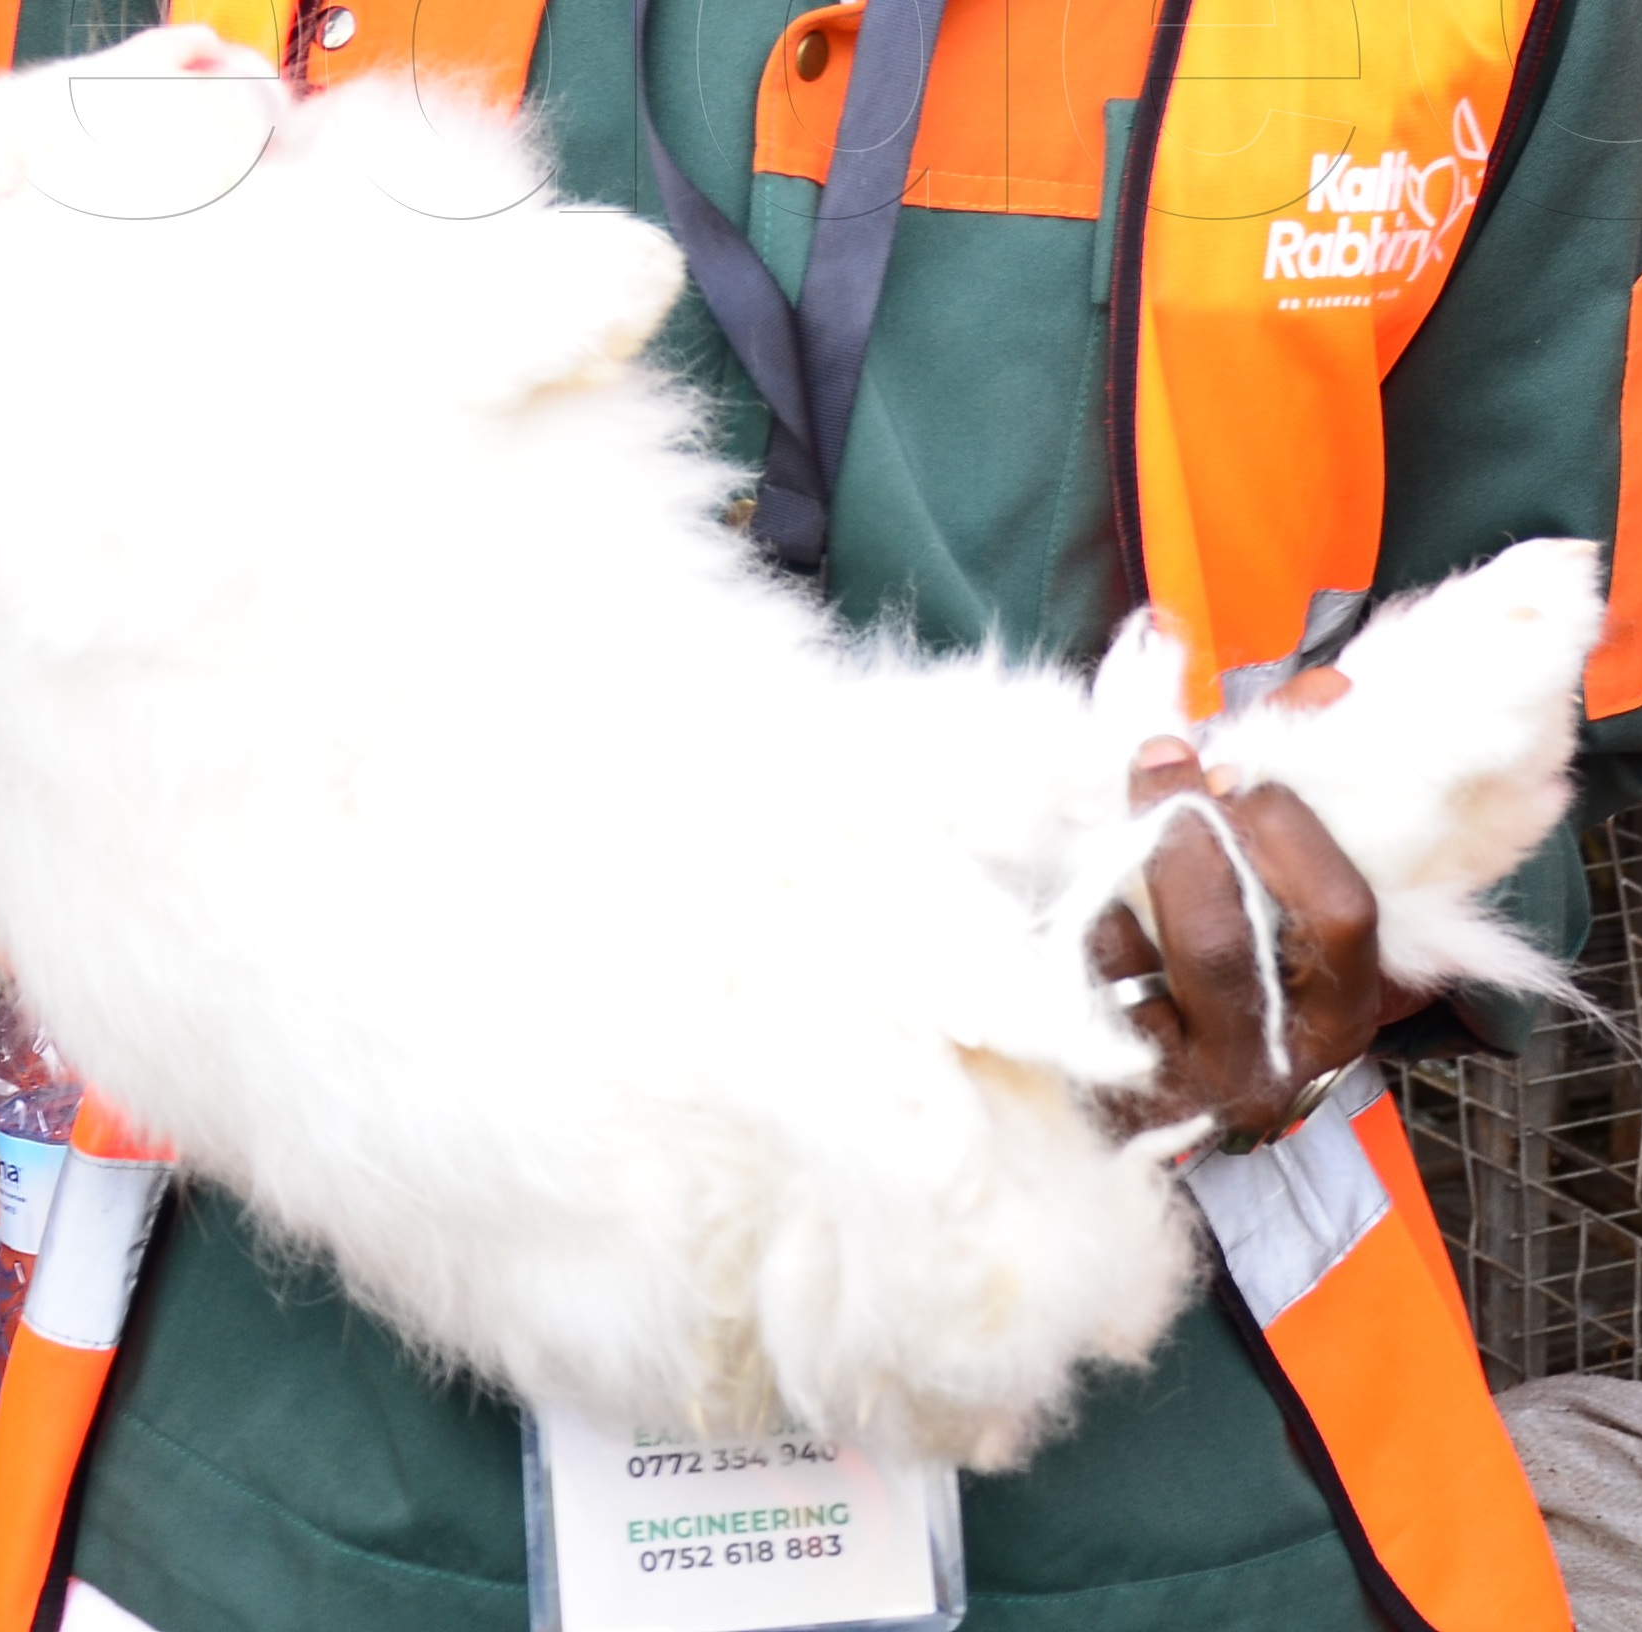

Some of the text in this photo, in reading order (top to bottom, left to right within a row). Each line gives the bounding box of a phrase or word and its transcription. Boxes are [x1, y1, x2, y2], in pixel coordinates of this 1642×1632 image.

[628, 1451, 704, 1479] 0772
[628, 1502, 851, 1544] ENGINEERING
[640, 1533, 843, 1573] 0752 618 883
